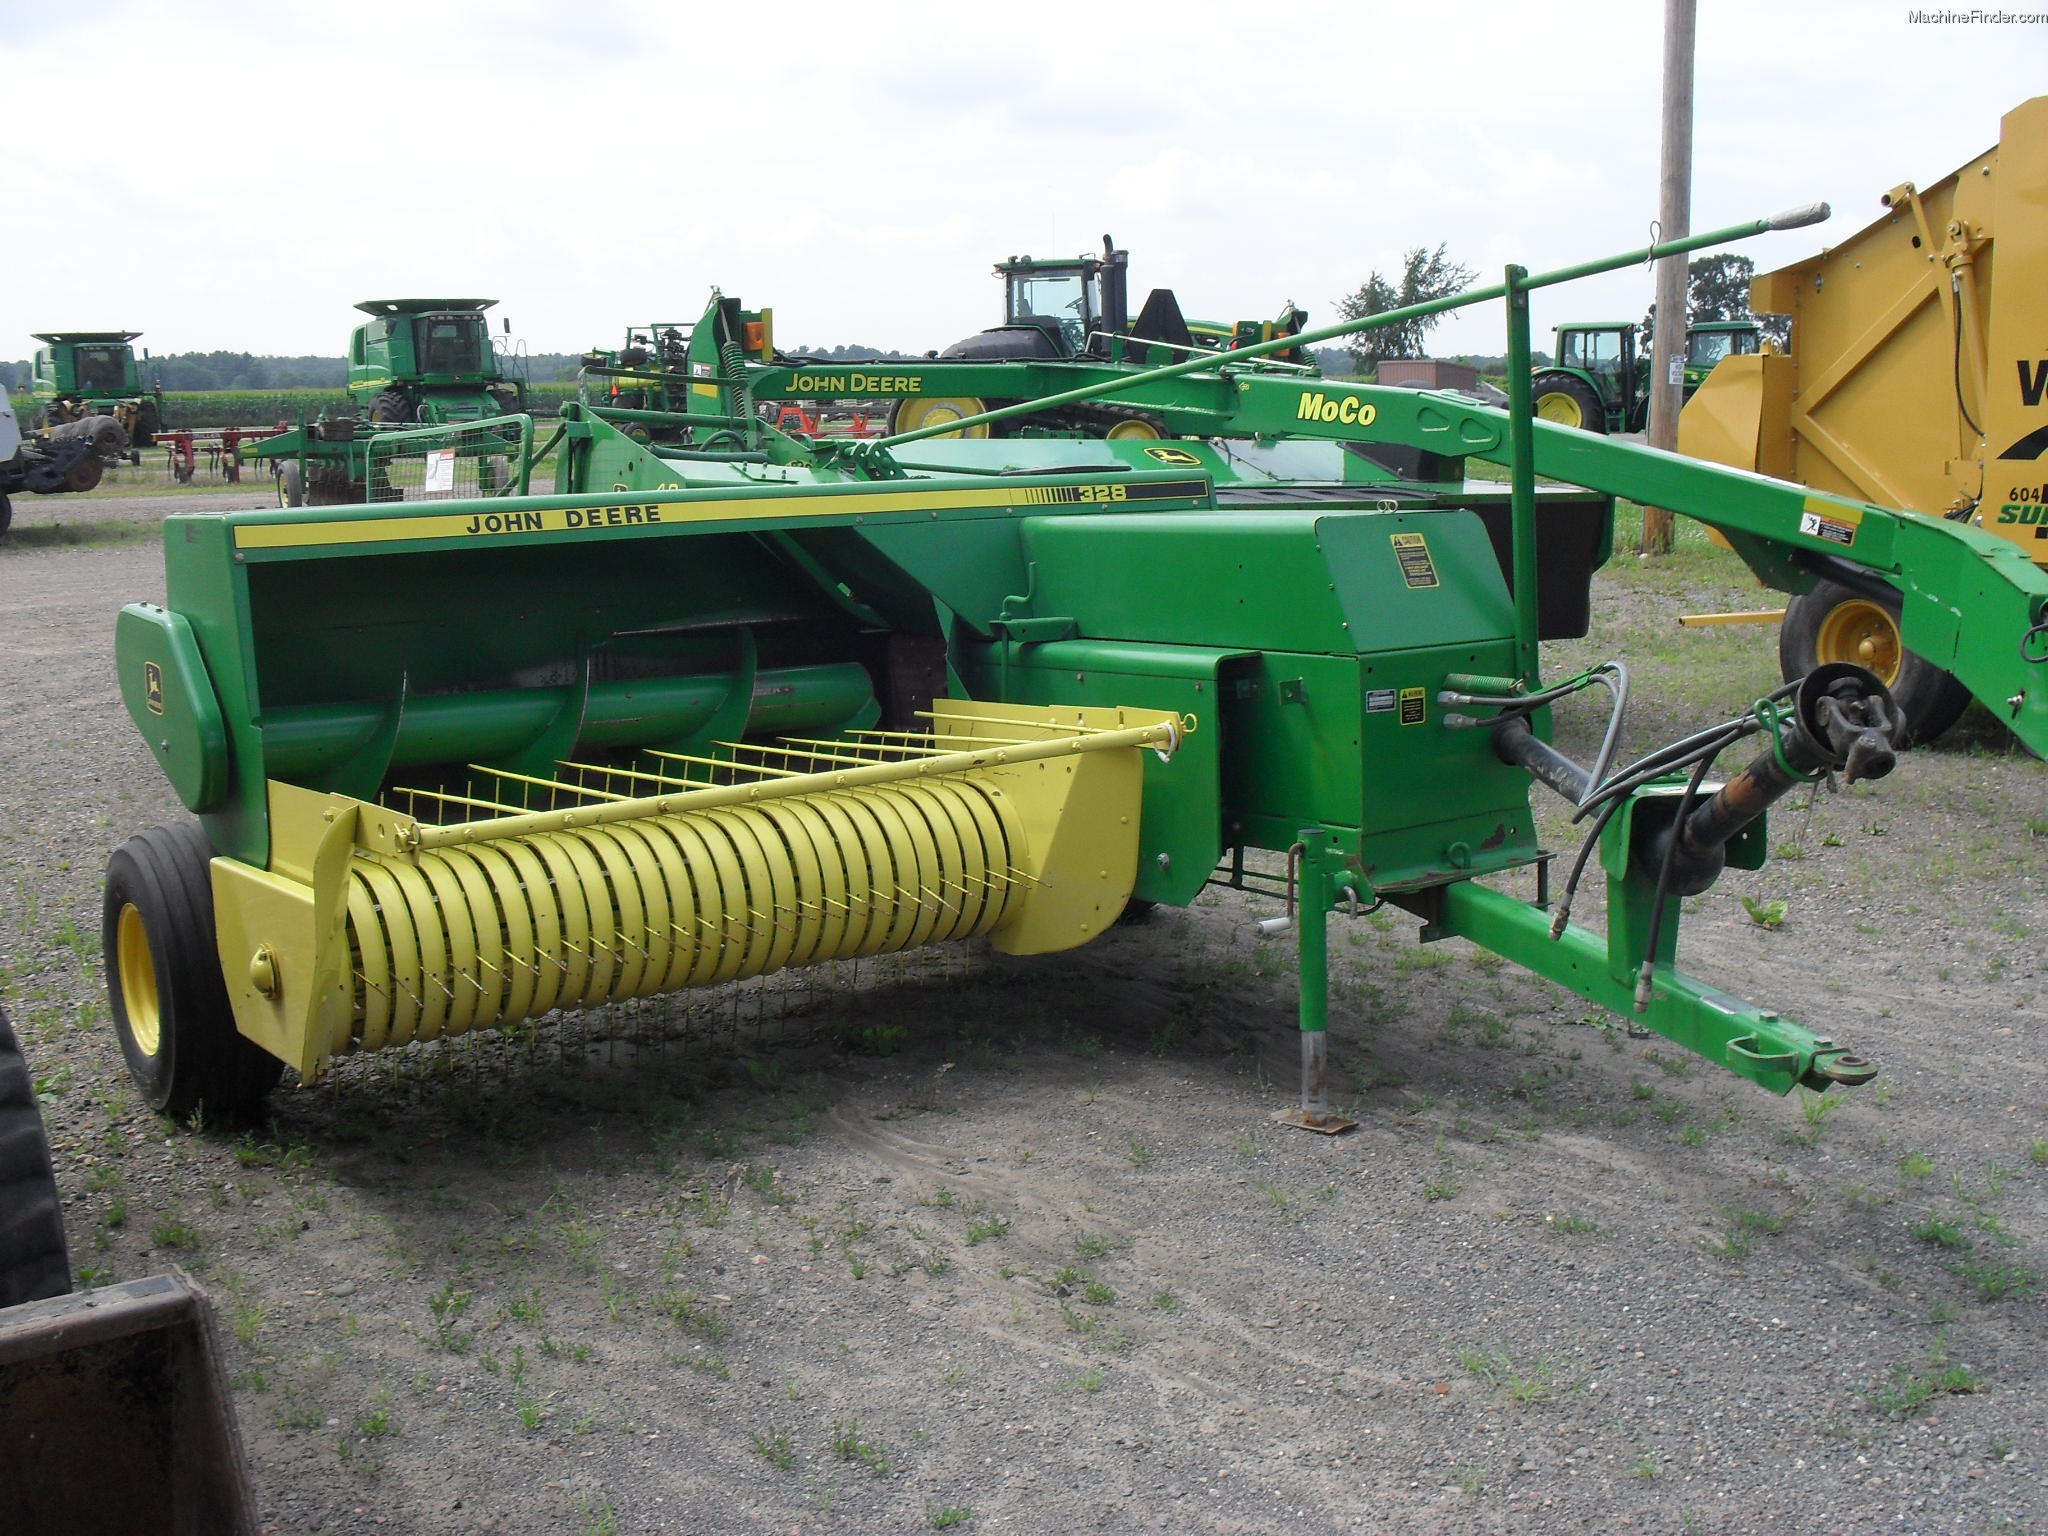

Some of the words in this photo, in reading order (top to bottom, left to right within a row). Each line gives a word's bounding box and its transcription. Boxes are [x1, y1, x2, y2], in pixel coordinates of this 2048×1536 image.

[785, 373, 845, 392] JOHN
[850, 373, 922, 392] DEERE
[1297, 392, 1376, 426] MoCo
[1079, 484, 1127, 502] 328
[2009, 487, 2040, 503] 604
[466, 512, 544, 534] JOHN
[565, 505, 661, 528] DEERE
